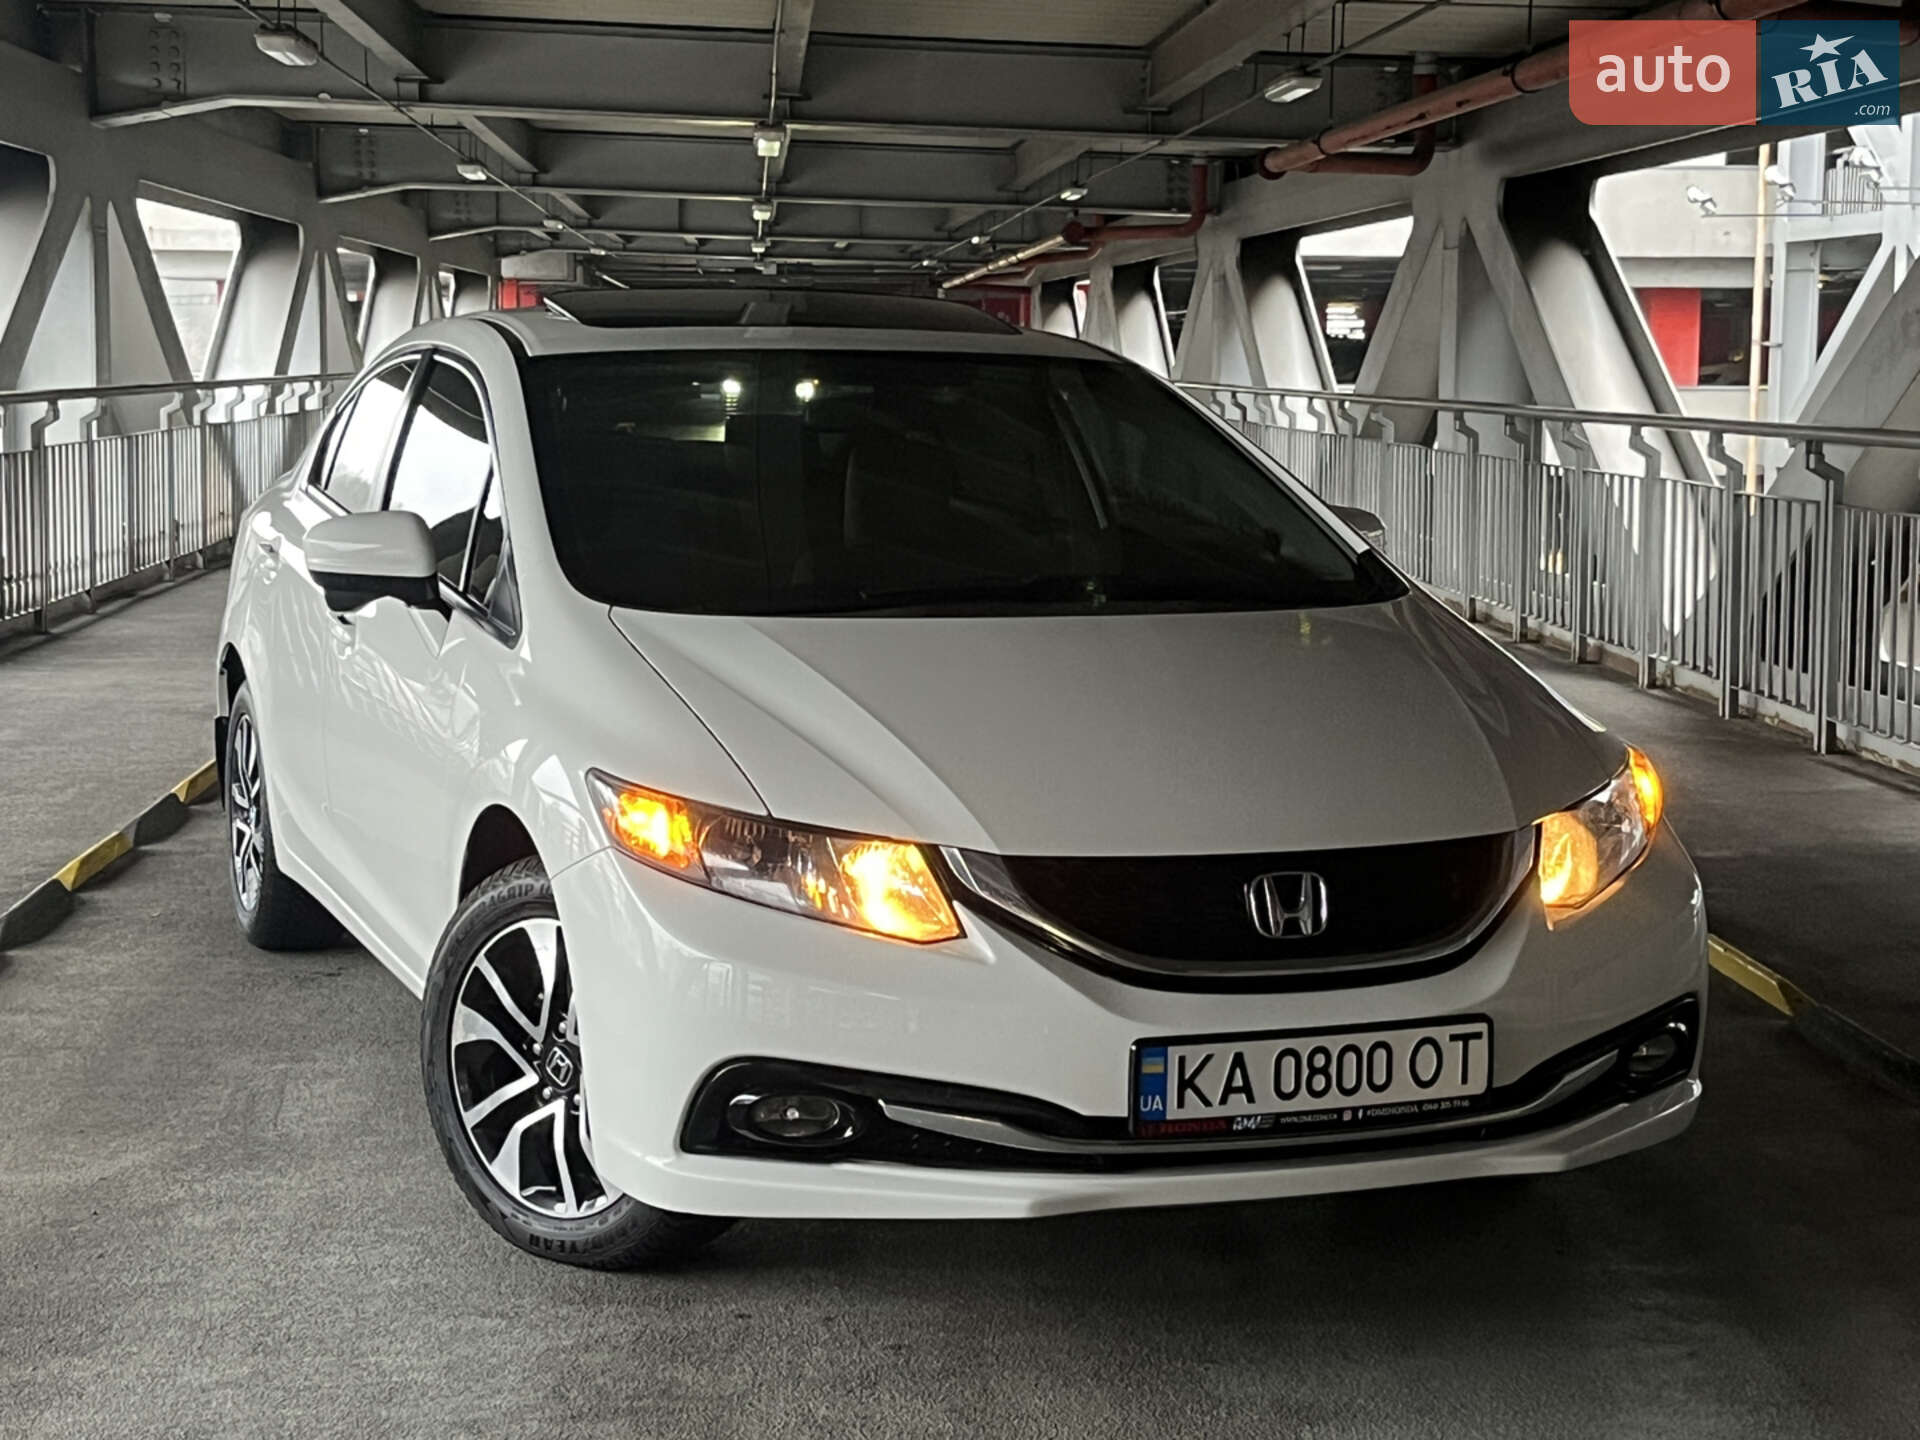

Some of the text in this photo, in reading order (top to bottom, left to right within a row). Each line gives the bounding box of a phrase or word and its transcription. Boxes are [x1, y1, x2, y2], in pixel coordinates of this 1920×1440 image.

[1176, 1031, 1484, 1110] KA 0800 OT
[1140, 1094, 1164, 1112] UA
